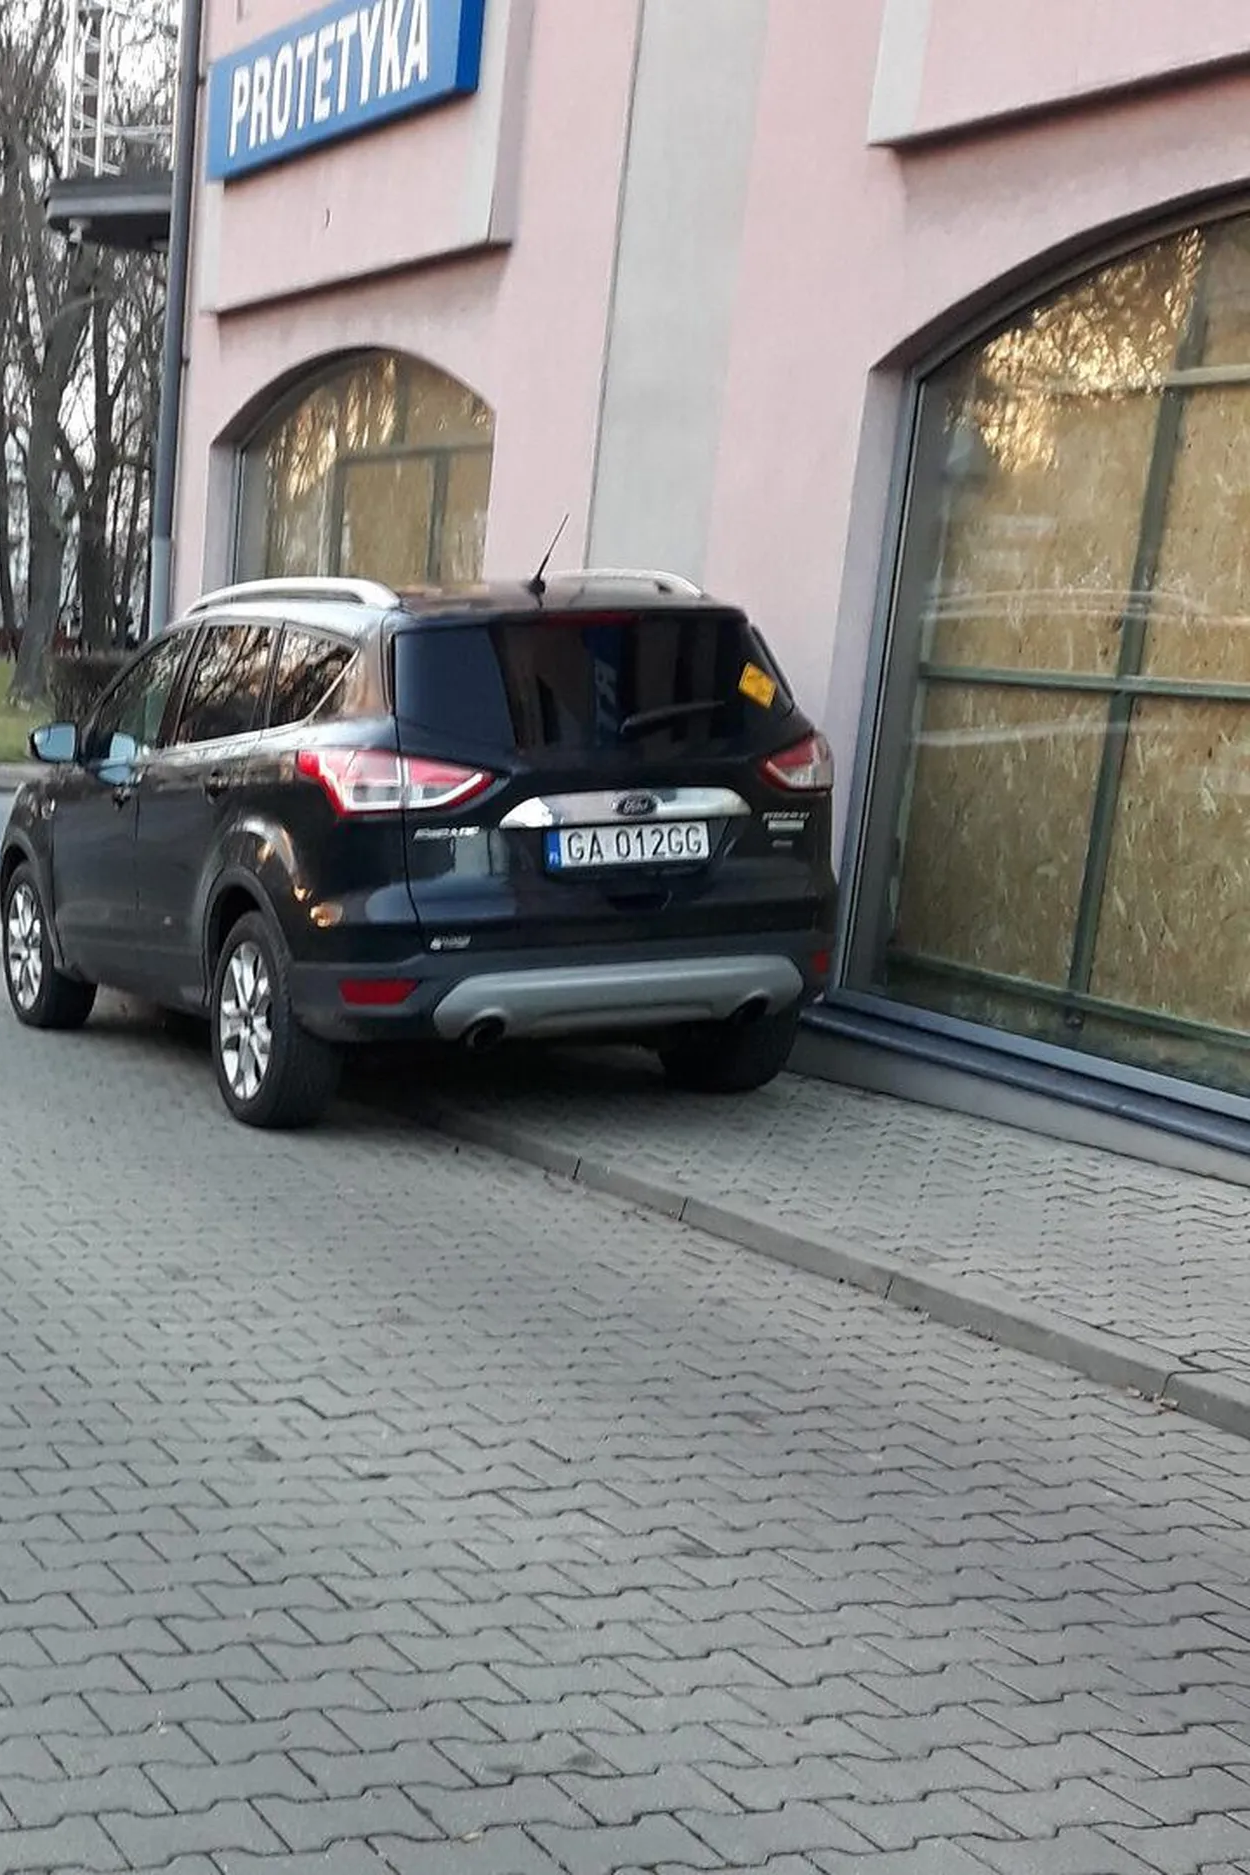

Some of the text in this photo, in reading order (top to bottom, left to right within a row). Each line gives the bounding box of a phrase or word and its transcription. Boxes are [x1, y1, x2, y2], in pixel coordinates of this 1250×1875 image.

[229, 0, 428, 157] PROTETYKA
[567, 830, 604, 865] GA
[615, 825, 702, 859] 012GG
